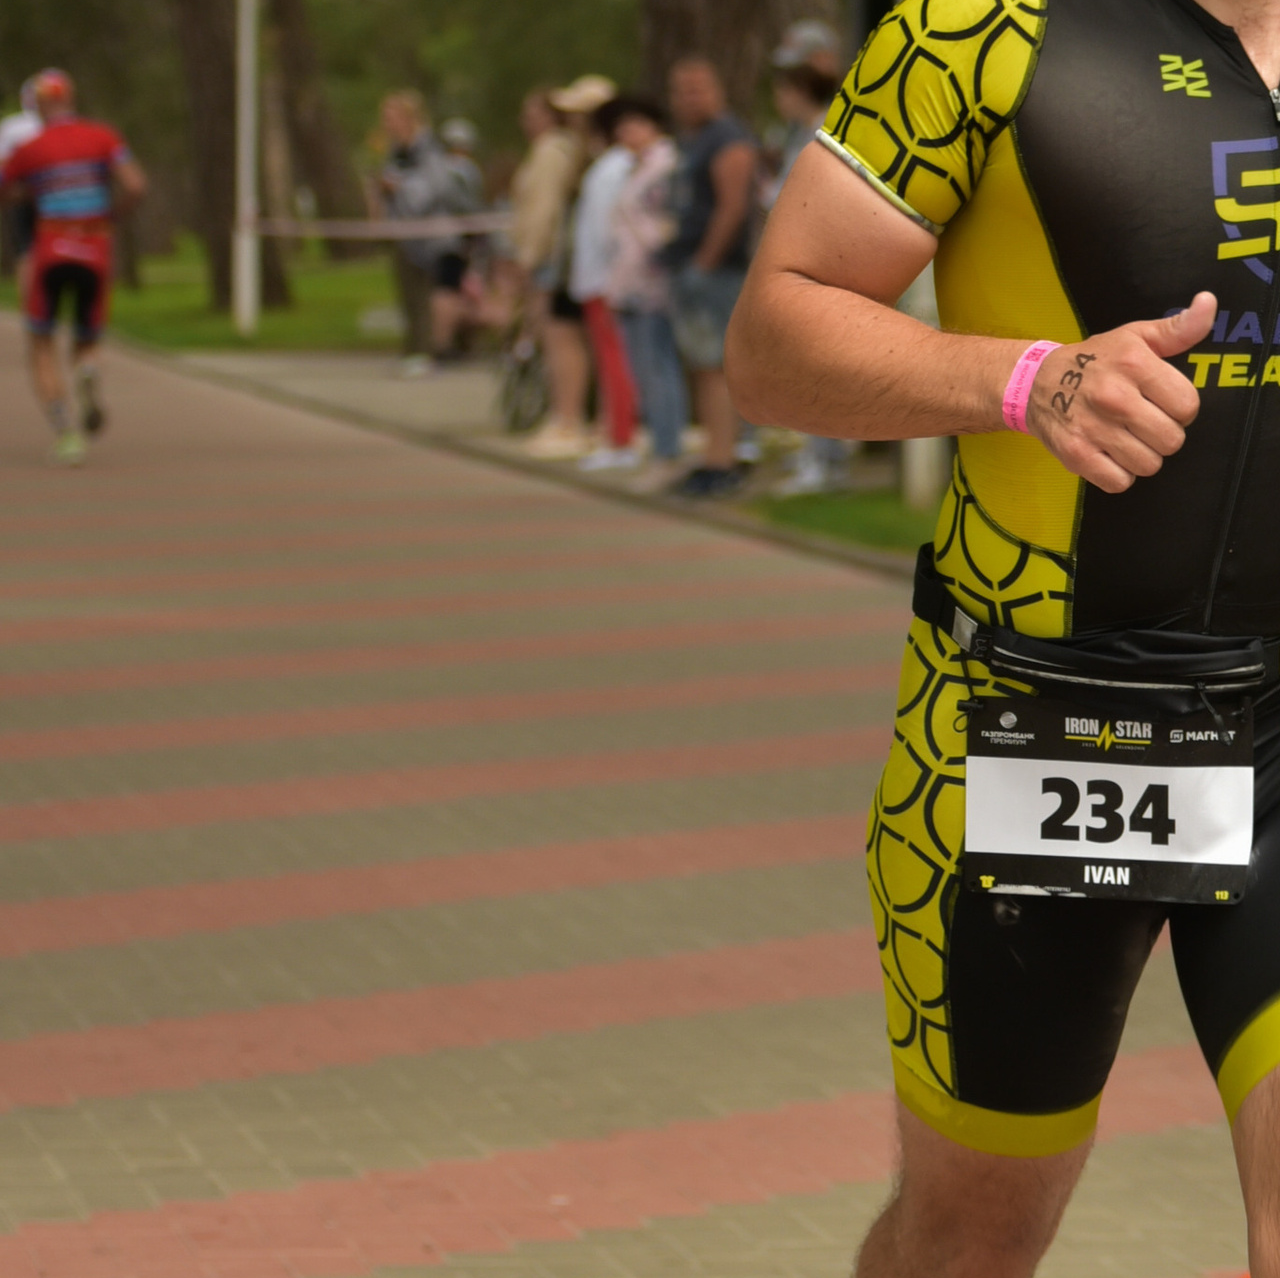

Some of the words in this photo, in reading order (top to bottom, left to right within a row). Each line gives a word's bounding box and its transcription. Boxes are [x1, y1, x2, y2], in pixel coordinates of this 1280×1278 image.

[1051, 353, 1097, 413] 234
[980, 730, 1036, 740] ГАЗПРОМБАНК
[1064, 717, 1100, 736] IRON
[1115, 720, 1153, 739] STAR
[1185, 730, 1237, 741] МАГНТ
[990, 737, 1027, 746] ПРЕМИУМ
[1040, 777, 1176, 845] 234
[1084, 865, 1131, 886] IVAN
